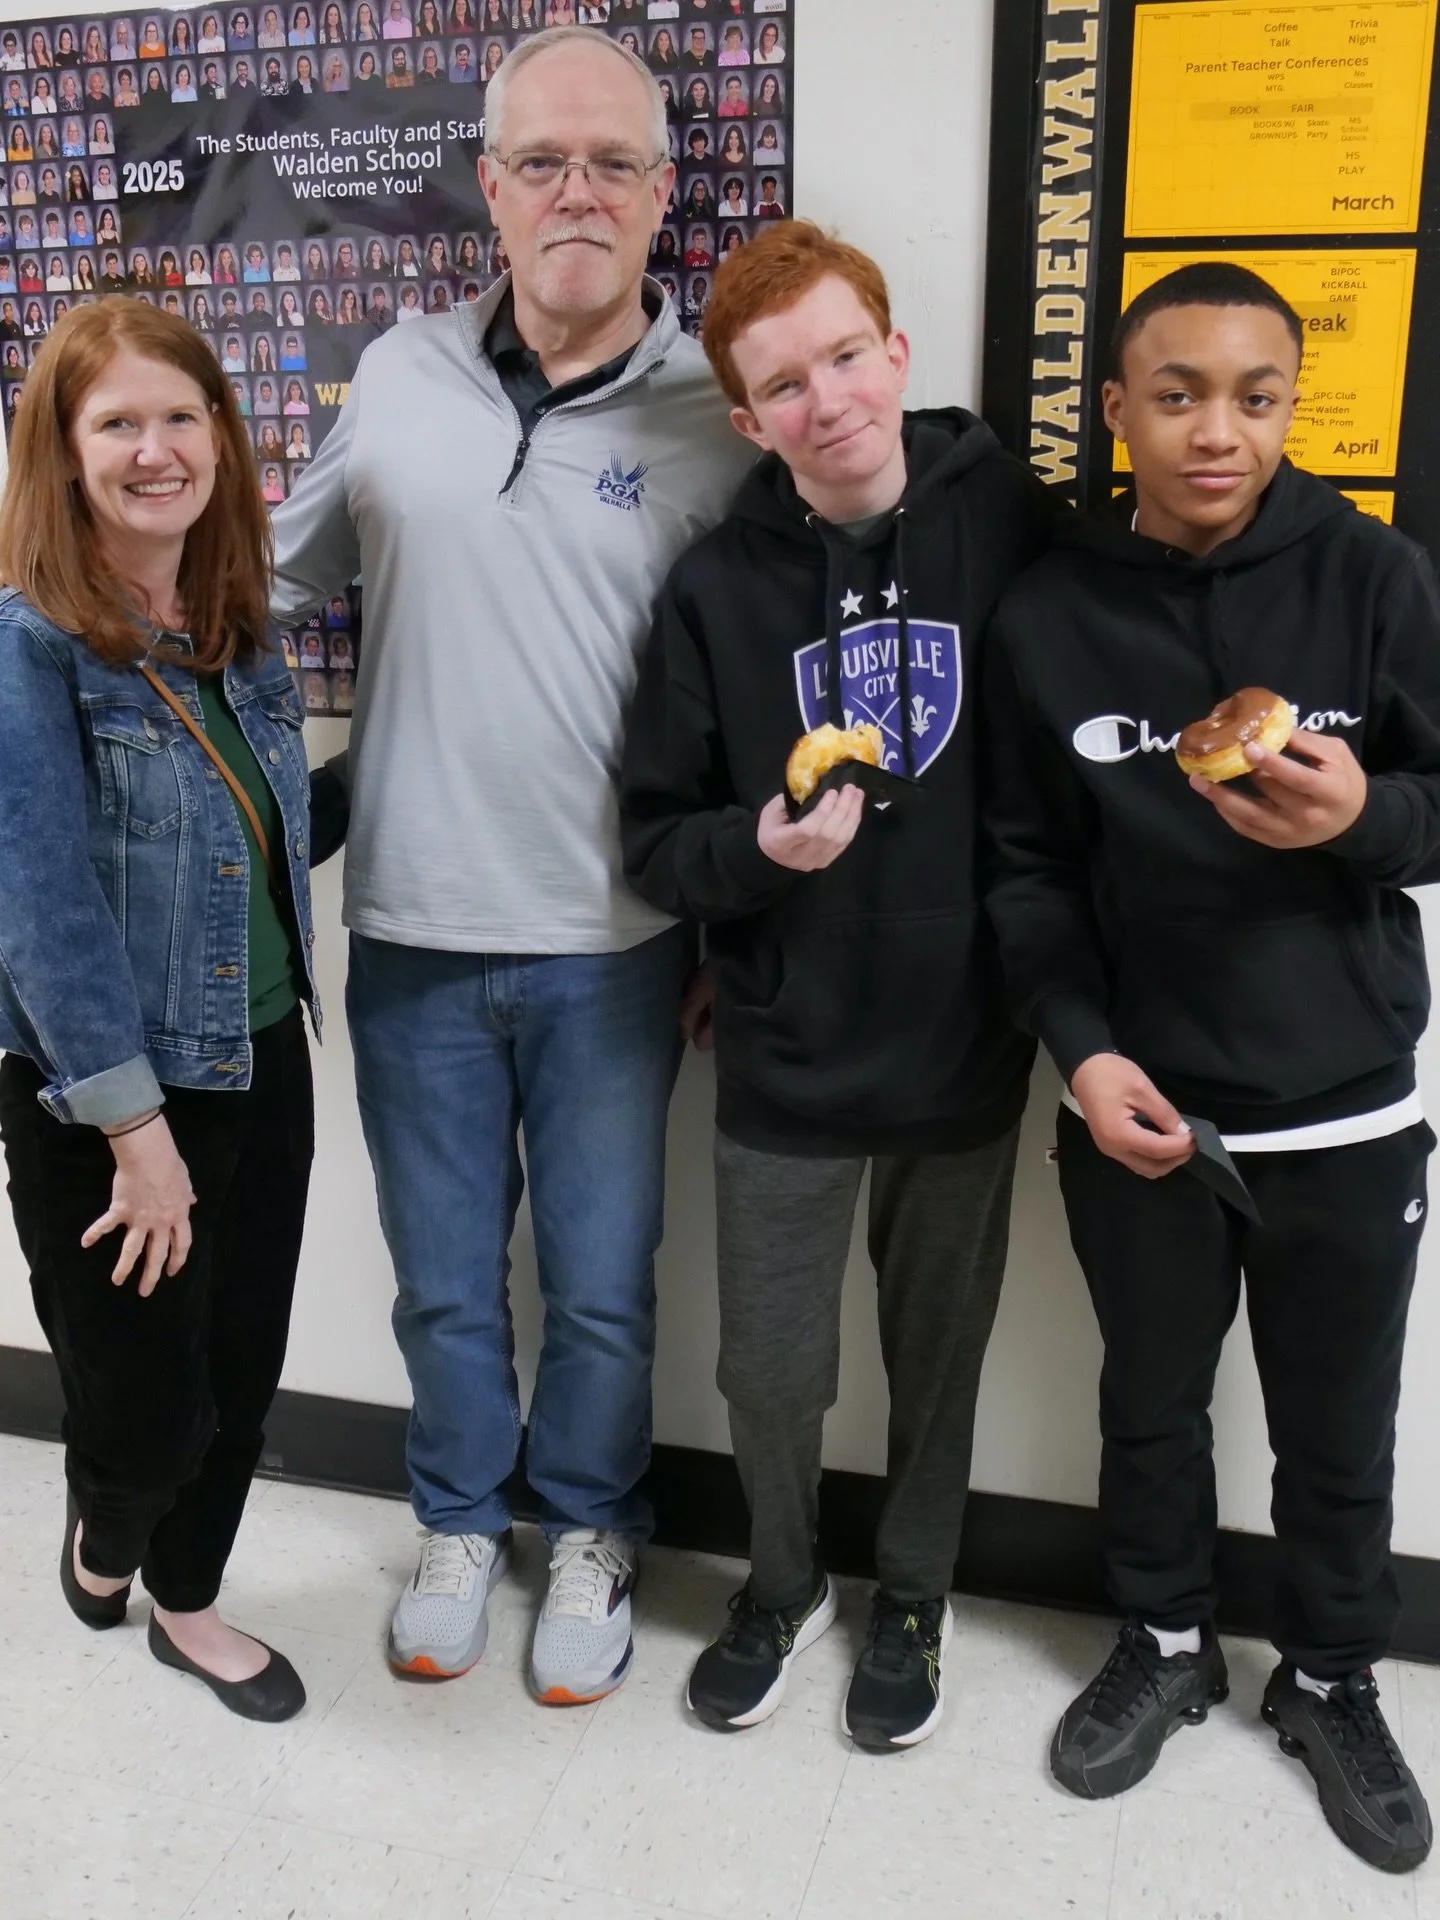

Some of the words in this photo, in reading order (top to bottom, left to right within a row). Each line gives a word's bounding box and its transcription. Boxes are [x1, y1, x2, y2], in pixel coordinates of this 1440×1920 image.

[1264, 23, 1298, 33] Coffee
[1350, 19, 1378, 29] Trivia
[1270, 37, 1291, 48] Talk
[1348, 34, 1377, 46] Night
[1185, 62, 1227, 74] Parent
[1231, 59, 1282, 72] Teacher
[1285, 55, 1369, 69] Conferences
[1229, 106, 1260, 115] BOOK
[1291, 104, 1314, 113] FAIR
[196, 135, 231, 155] The
[235, 129, 325, 155] Students,
[330, 124, 399, 149] Faculty
[404, 120, 441, 142] and
[1306, 131, 1328, 140] Party
[273, 152, 359, 176] Walden
[366, 146, 442, 173] School
[1346, 152, 1360, 160] HS
[122, 160, 185, 193] 2025
[1338, 167, 1366, 175] PLAY
[292, 176, 378, 199] Welcome
[382, 175, 424, 195] You!
[1332, 195, 1394, 211] March
[1330, 268, 1361, 276] BIPOC
[1321, 281, 1367, 289] KICKBALL
[1329, 294, 1358, 303] GAME
[1302, 313, 1347, 332] reak
[1313, 392, 1334, 401] GPC
[1335, 391, 1357, 401] Club
[1315, 405, 1350, 414] Walden
[1311, 418, 1325, 427] HS
[1329, 418, 1354, 427] Prom
[1333, 438, 1379, 459] April
[595, 477, 641, 505] PGA
[864, 672, 898, 699] CITY
